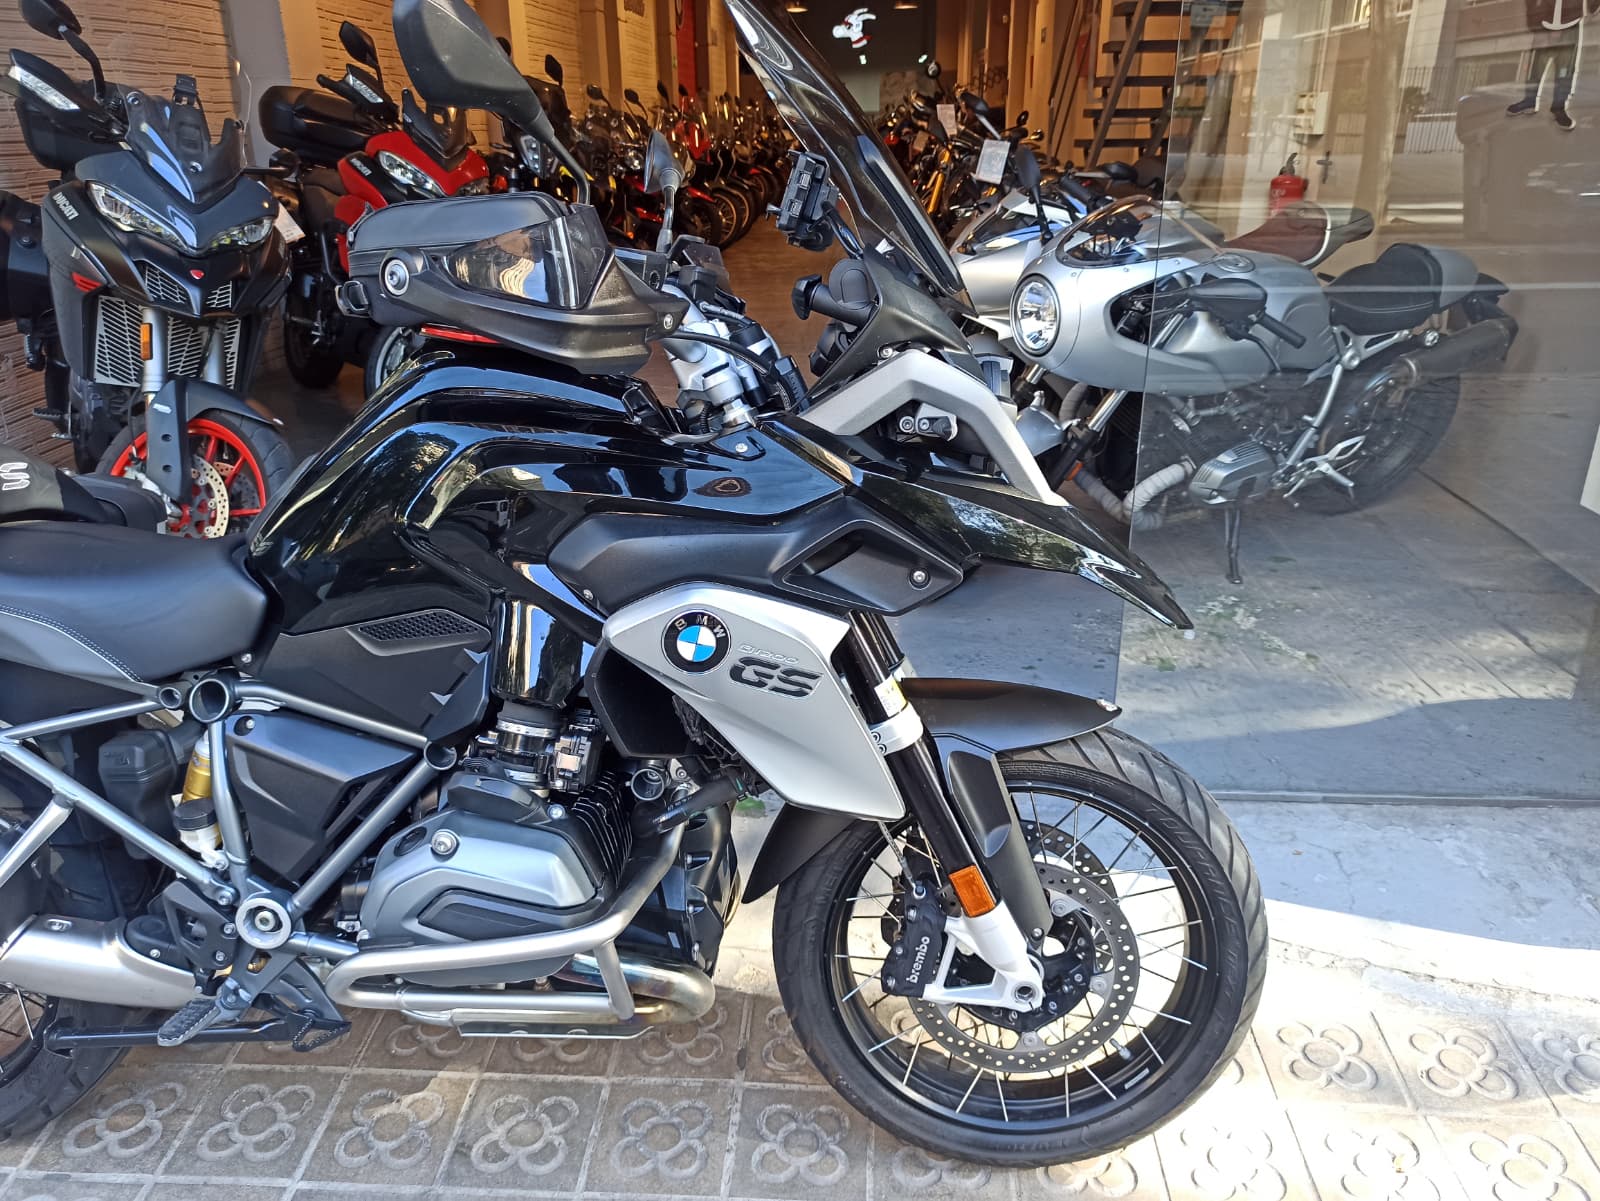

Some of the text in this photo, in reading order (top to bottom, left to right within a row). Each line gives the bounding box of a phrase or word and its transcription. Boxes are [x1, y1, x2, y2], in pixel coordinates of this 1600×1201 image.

[52, 191, 80, 221] DUCATI
[674, 613, 727, 639] BMW
[728, 655, 824, 699] GS
[905, 935, 931, 984] brembo
